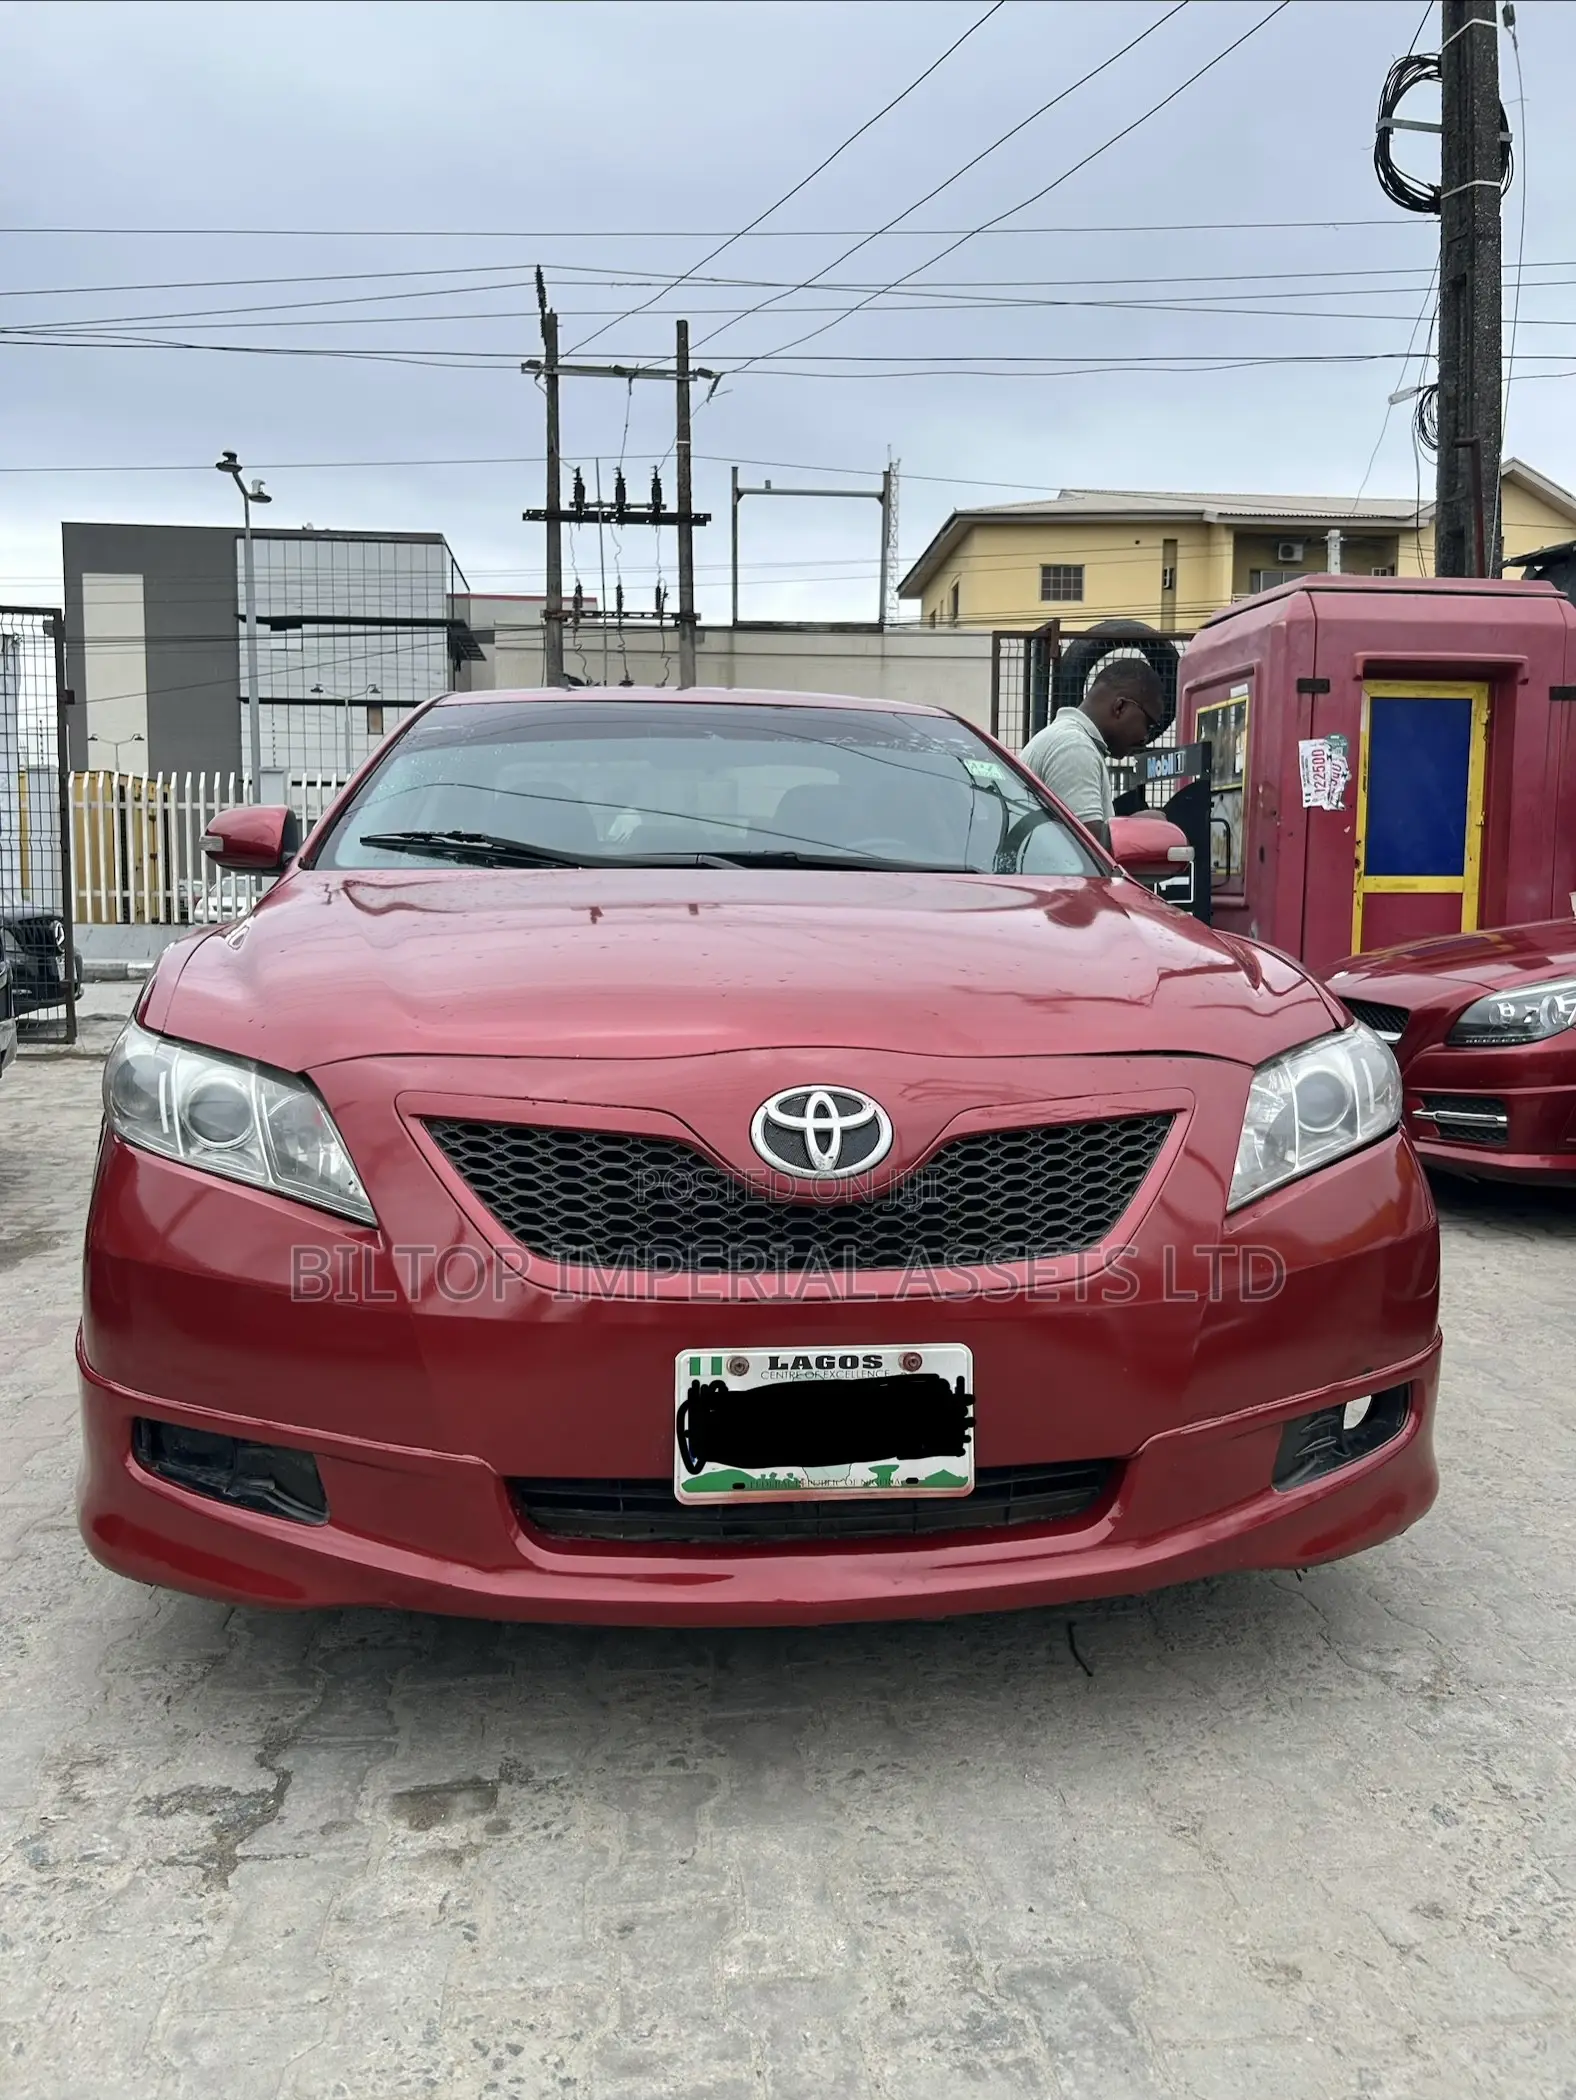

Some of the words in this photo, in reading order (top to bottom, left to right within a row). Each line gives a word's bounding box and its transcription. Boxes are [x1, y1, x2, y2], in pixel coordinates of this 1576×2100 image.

[1147, 752, 1174, 779] Mobil
[768, 1355, 883, 1370] LAGOS
[760, 1370, 804, 1380] CENTRE
[805, 1370, 821, 1380] OF
[822, 1369, 890, 1380] EXCELLENCE
